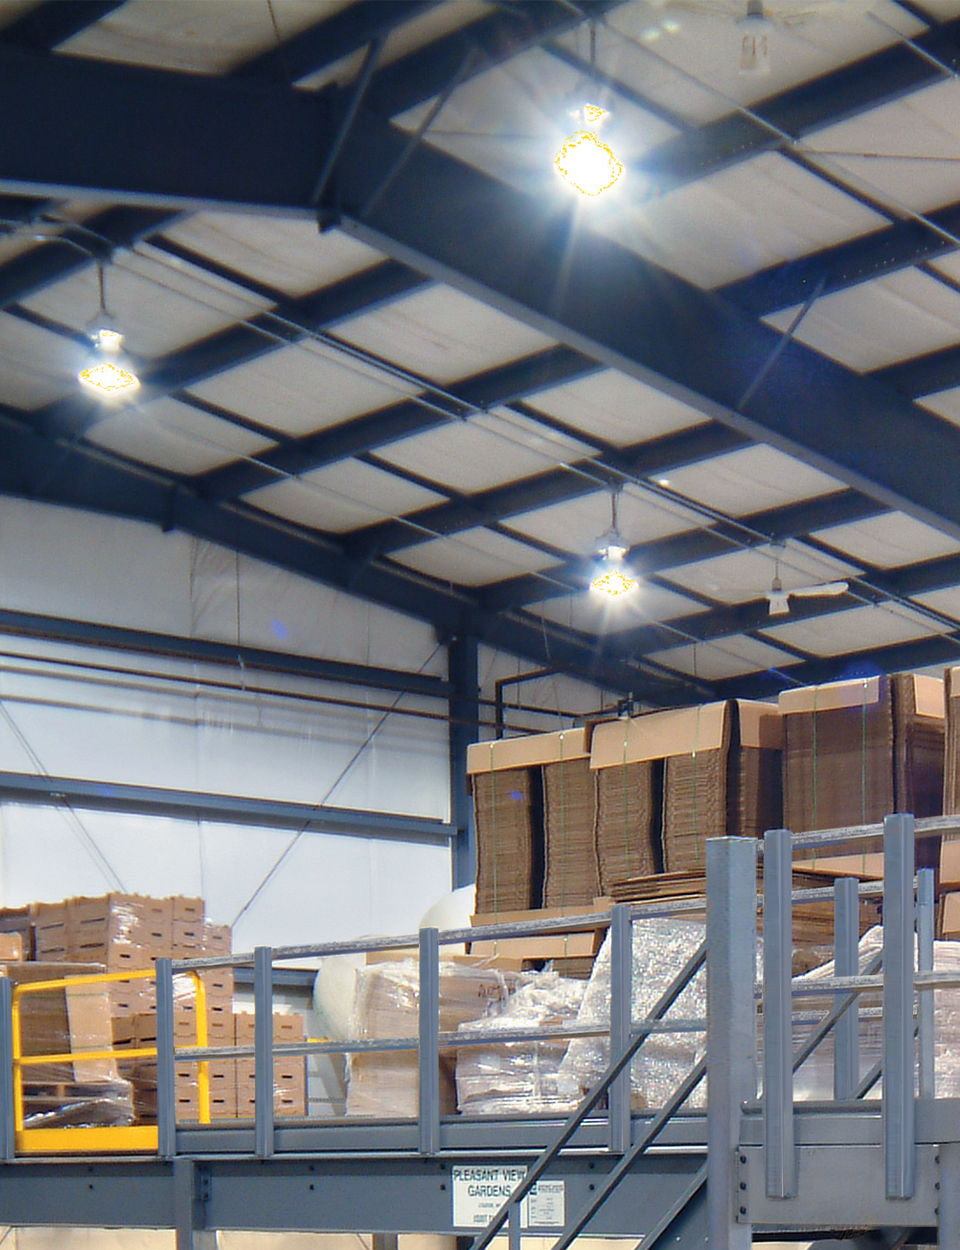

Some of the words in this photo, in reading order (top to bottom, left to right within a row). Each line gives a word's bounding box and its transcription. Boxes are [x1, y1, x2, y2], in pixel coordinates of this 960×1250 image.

[454, 1169, 498, 1180] PLEASANT
[502, 1169, 526, 1180] VIEW
[468, 1184, 512, 1197] GARDENS
